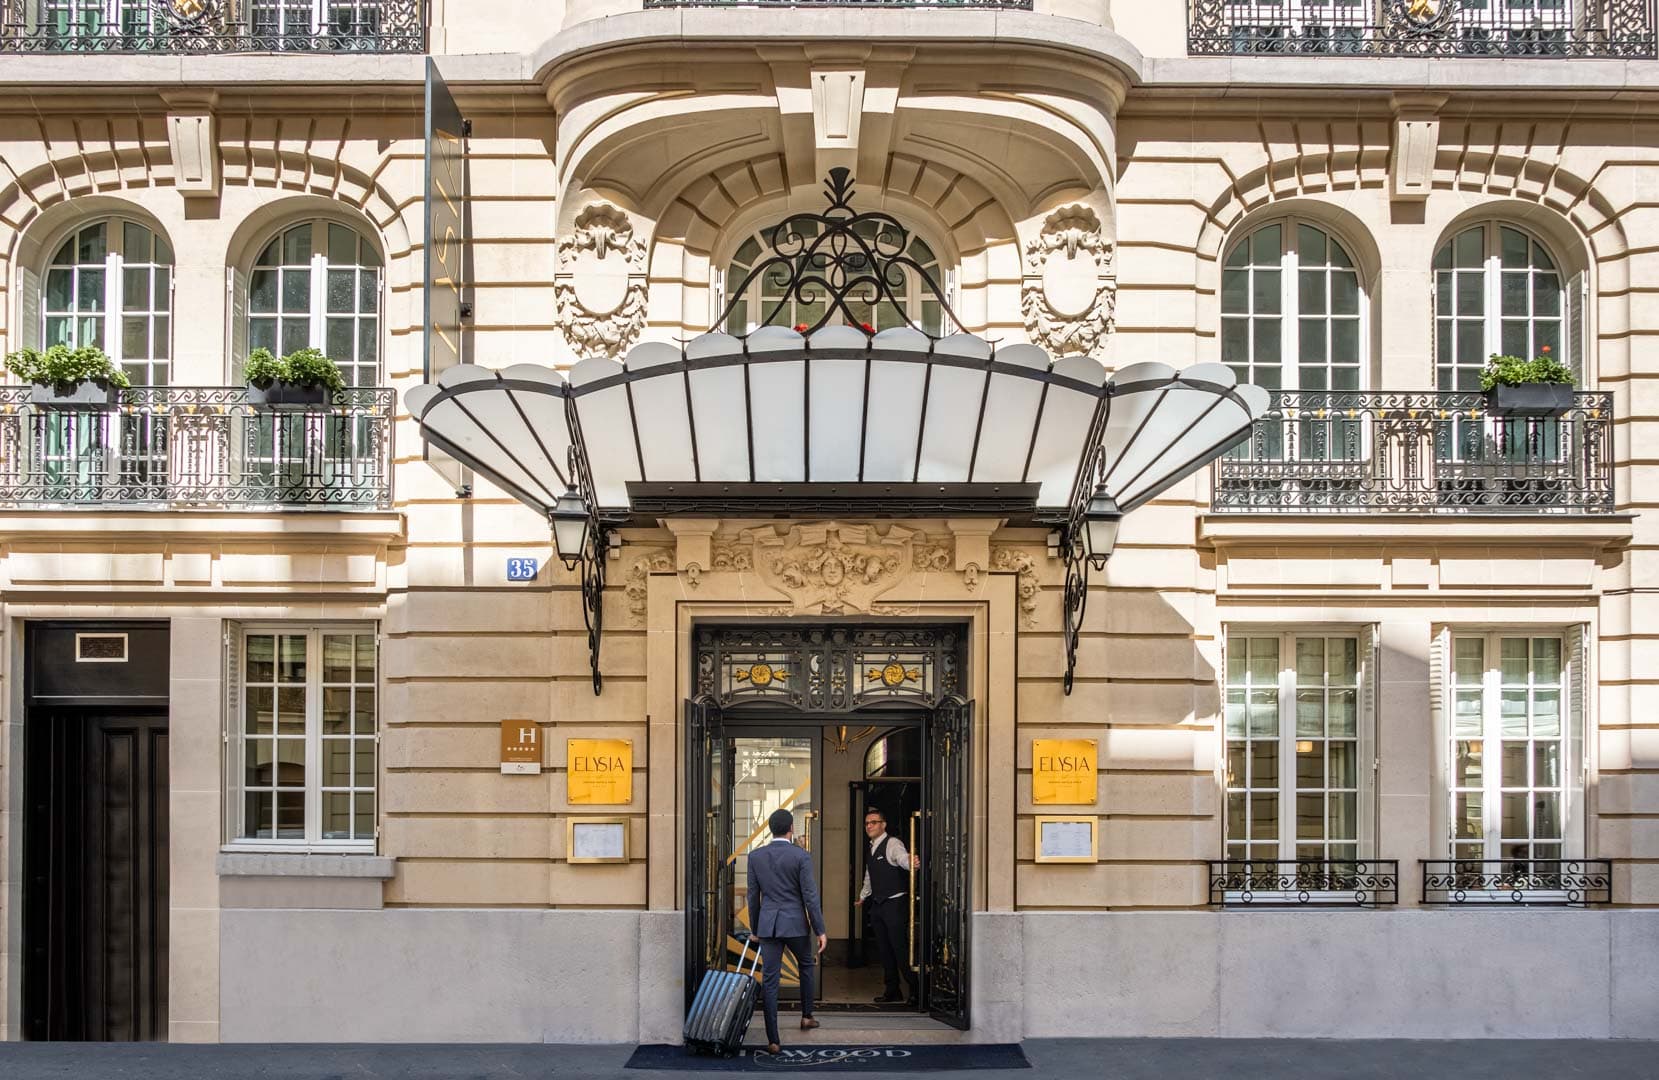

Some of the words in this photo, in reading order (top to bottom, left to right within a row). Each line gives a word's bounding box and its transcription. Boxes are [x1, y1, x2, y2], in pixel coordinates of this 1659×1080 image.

[434, 128, 459, 385] LYSIA
[510, 559, 535, 578] 35
[519, 727, 536, 744] H
[574, 756, 625, 772] ELYSIA
[1039, 756, 1090, 772] ELYSIA
